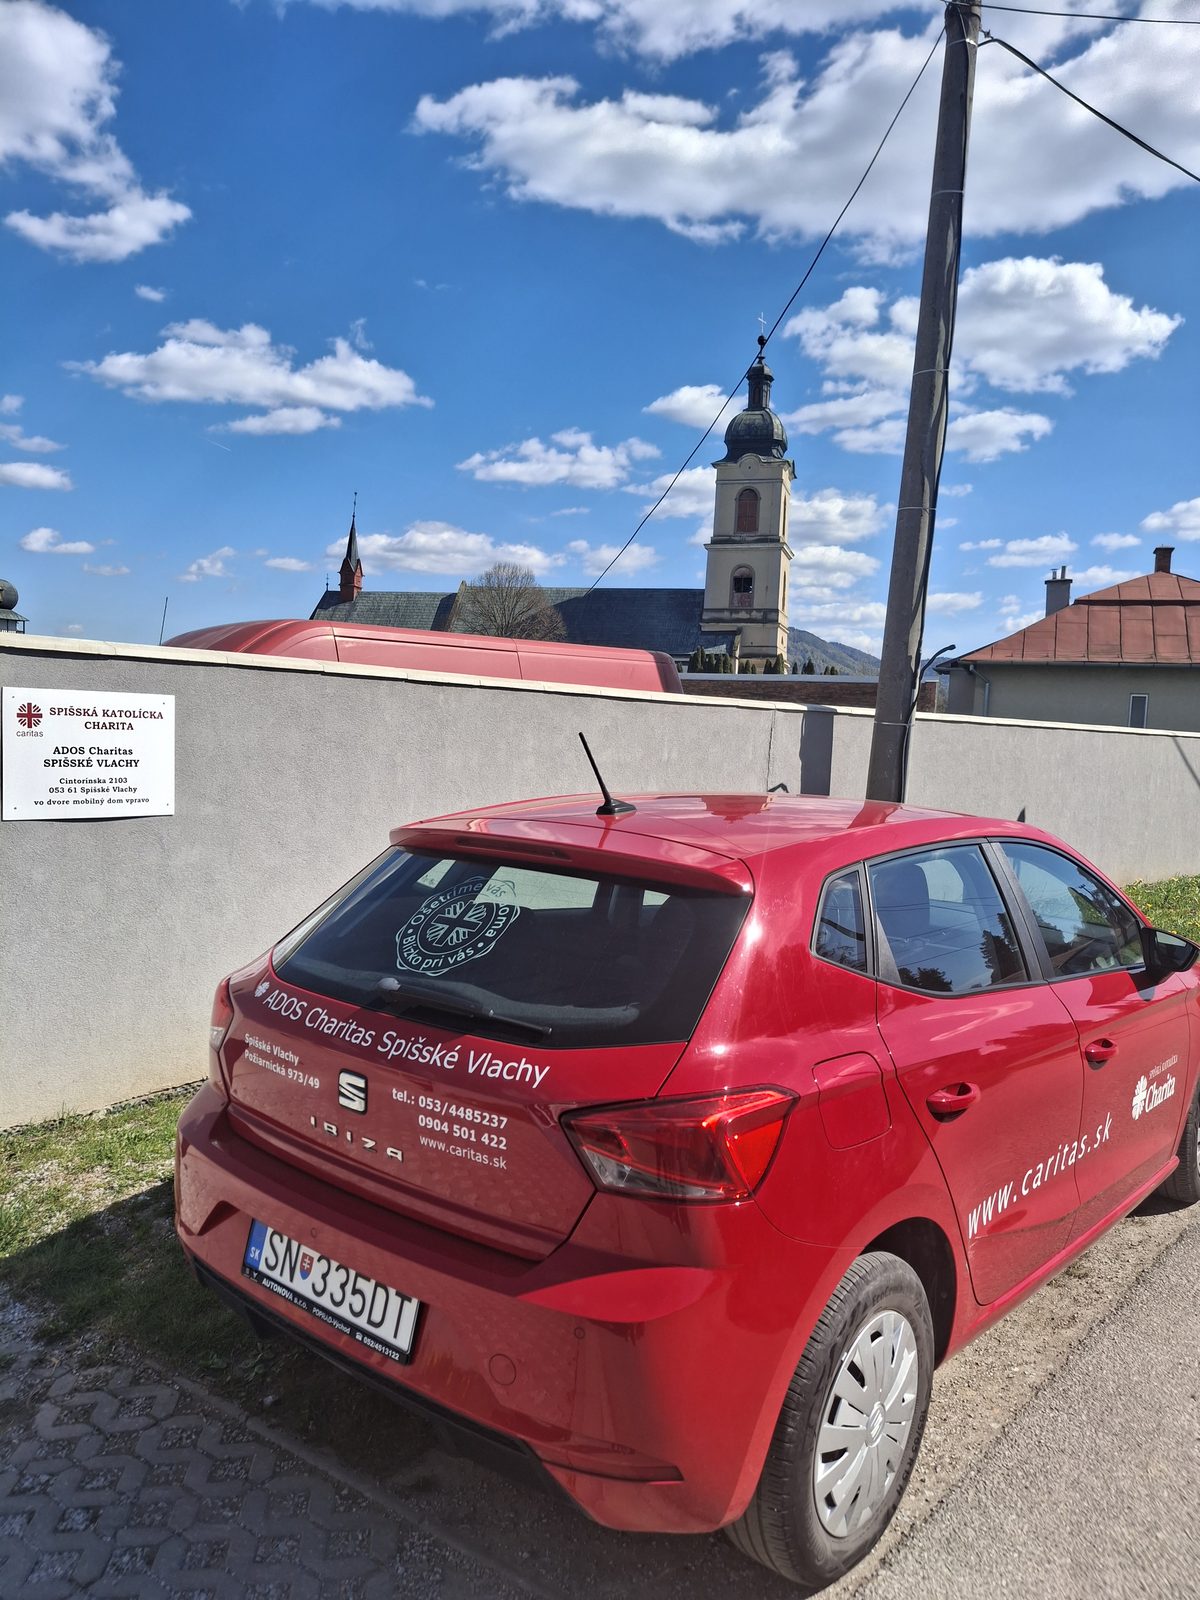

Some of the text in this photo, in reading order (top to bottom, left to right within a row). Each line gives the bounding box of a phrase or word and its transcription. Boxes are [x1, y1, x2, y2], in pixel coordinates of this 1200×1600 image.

[50, 706, 164, 720] SPIŠSKÁ KATOLÍCKA
[84, 722, 134, 730] CHARITA
[16, 730, 44, 738] caritas
[44, 757, 140, 768] SPIŠSKÉ VLACHY
[53, 746, 133, 756] ADOS Charitas
[72, 798, 104, 806] mobilný
[126, 797, 150, 805] vpravo
[80, 786, 110, 794] Spišské
[112, 786, 138, 794] Vlachy
[486, 883, 506, 898] vás
[485, 902, 510, 937] oma
[402, 934, 475, 971] Blízko pri vás
[244, 1033, 300, 1066] Spišské Vlachy
[263, 989, 550, 1089] ADOS Charitas Spišské Vlachy
[287, 1068, 320, 1089] 973/49
[1145, 1073, 1176, 1113] Charita
[392, 1088, 508, 1129] tel.: 053/4485237
[310, 1115, 403, 1163] IBIZA
[418, 1114, 507, 1150] 0904 501 422
[419, 1135, 507, 1170] www.caritas.sk
[968, 1112, 1112, 1239] www.caritas.sk
[250, 1246, 260, 1261] SK
[262, 1278, 294, 1302] AUTONOVA
[264, 1230, 412, 1339] SN 335DT
